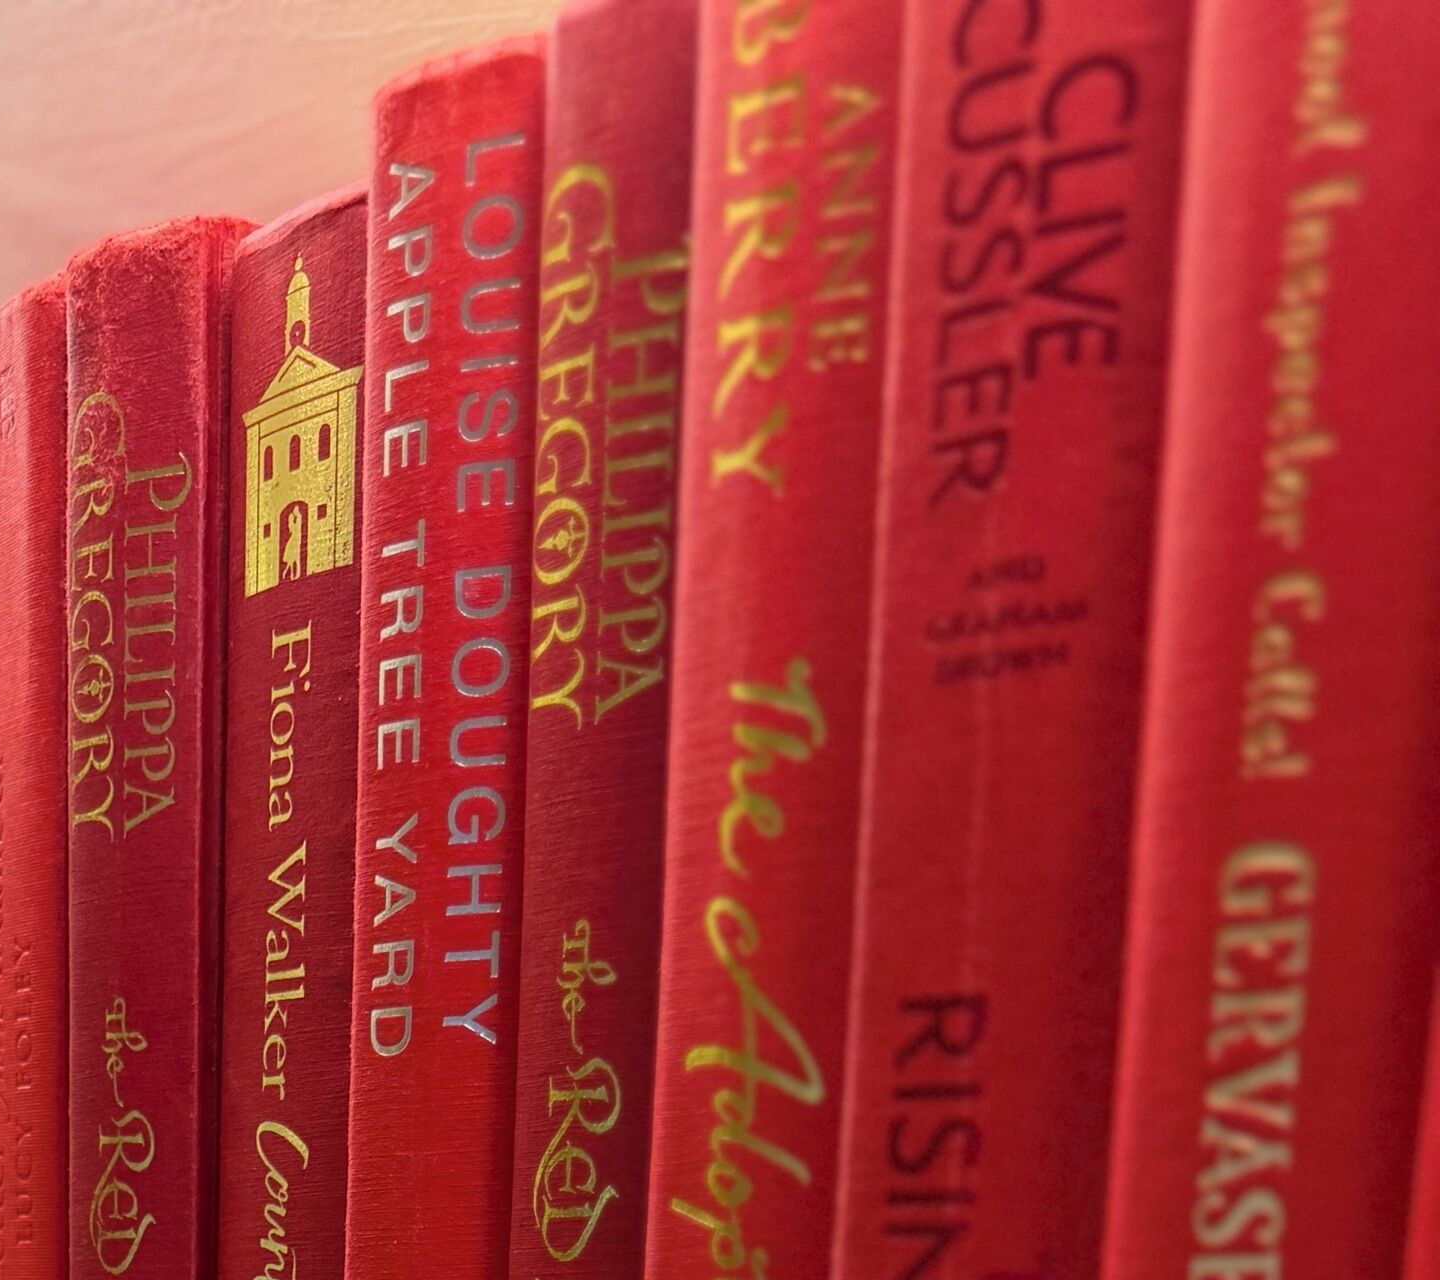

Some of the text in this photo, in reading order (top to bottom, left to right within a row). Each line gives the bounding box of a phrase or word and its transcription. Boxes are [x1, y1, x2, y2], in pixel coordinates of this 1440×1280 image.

[530, 163, 617, 730] GREGORY
[710, 0, 806, 498] BERRY
[808, 83, 881, 373] ANNE
[925, 0, 1044, 511] CUSSLER
[1024, 53, 1140, 381] CLIVE
[69, 391, 126, 843] GREGORY
[123, 452, 193, 839] PHILIPPA
[370, 163, 435, 1056] APPLE TREE YARD
[442, 133, 527, 1044] LOUISE DOUGHTY
[594, 228, 692, 725] PHILIPPA
[262, 618, 312, 1100] Fiona Walker
[719, 656, 827, 878] The
[12, 939, 34, 1248] LUCY FOLEY
